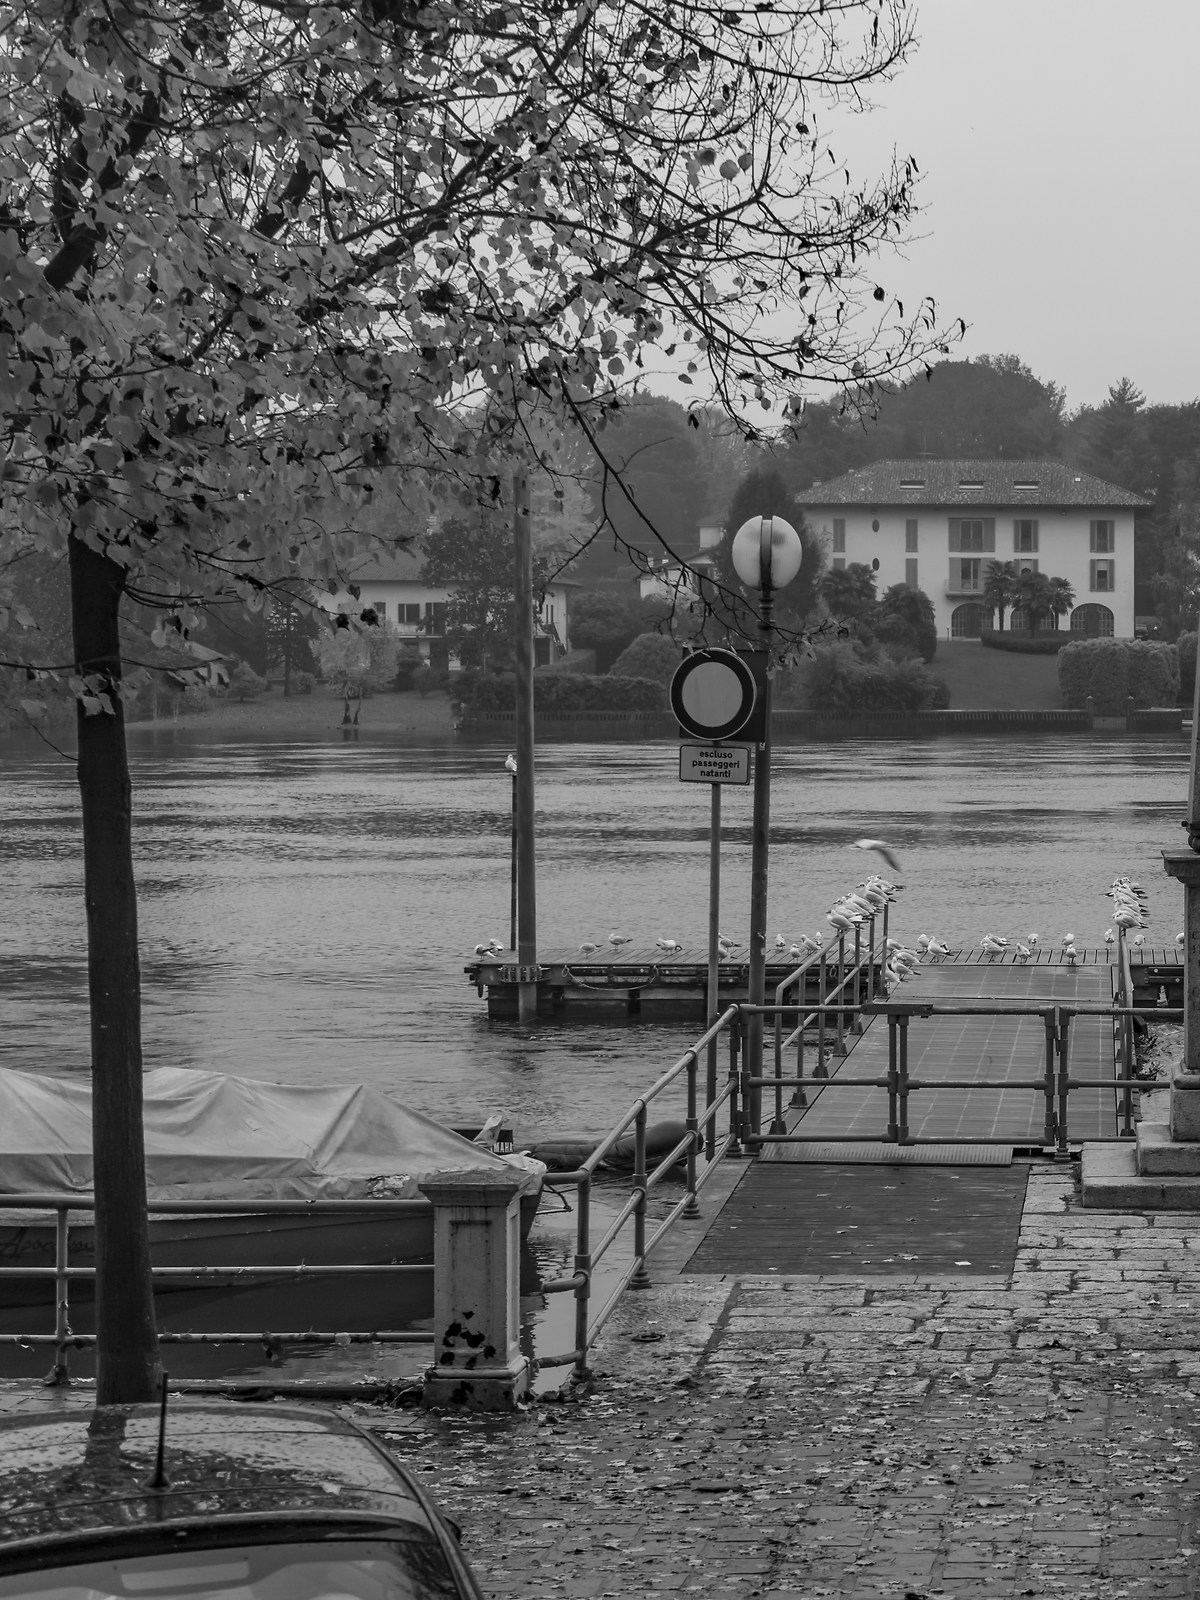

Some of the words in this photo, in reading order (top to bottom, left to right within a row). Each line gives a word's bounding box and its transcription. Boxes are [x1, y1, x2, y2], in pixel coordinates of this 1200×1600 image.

[700, 750, 733, 759] escluso
[692, 760, 740, 769] passeggeri
[700, 769, 731, 778] natanti
